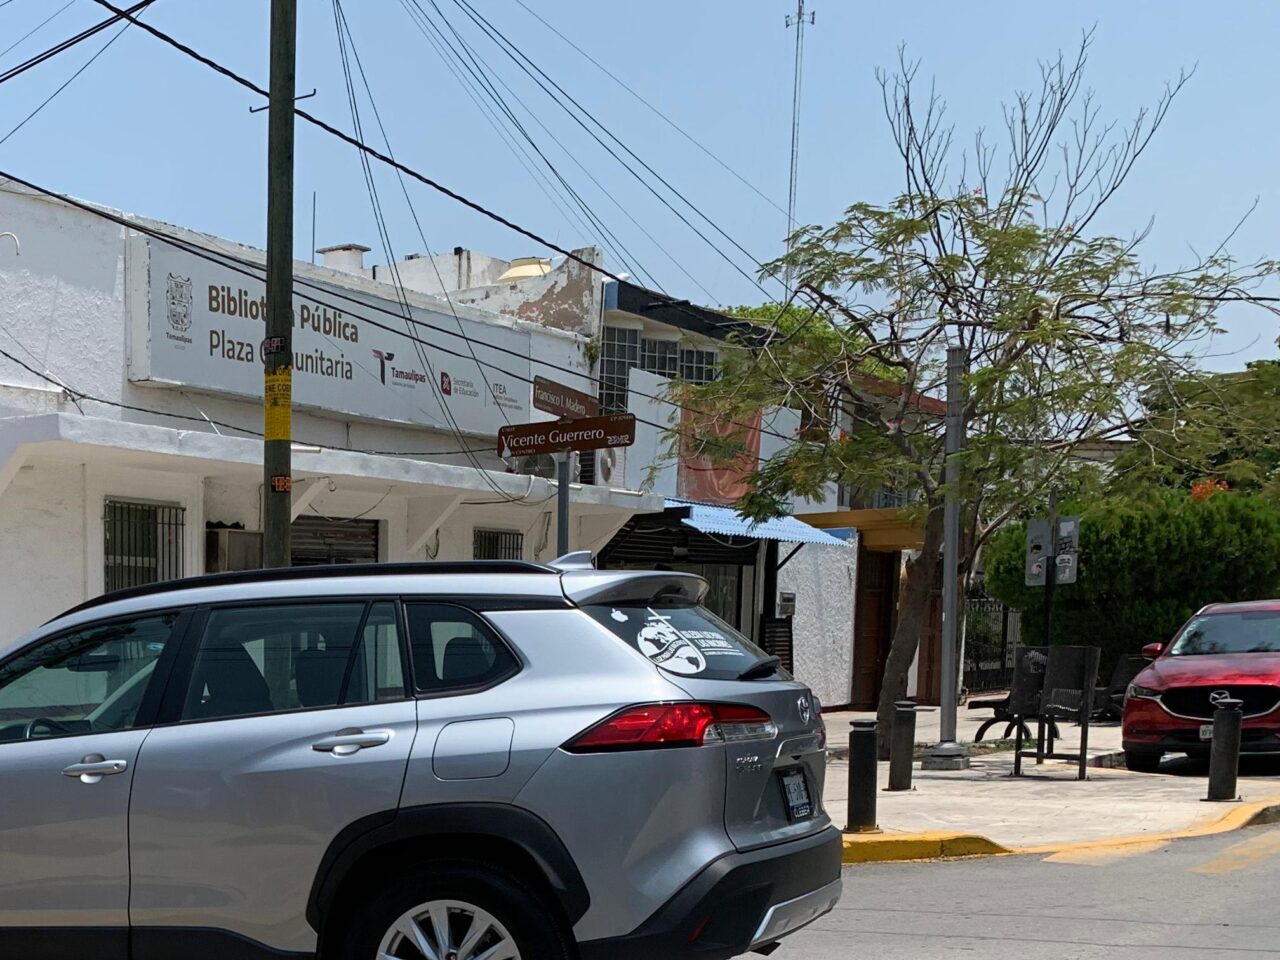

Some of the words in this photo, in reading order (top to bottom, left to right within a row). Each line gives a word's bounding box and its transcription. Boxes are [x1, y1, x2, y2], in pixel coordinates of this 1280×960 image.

[208, 285, 295, 327] Bibliot
[300, 304, 359, 343] Pública
[210, 330, 254, 363] Plaza
[260, 337, 353, 380] Cunitaria
[391, 367, 426, 384] Tamaulipas
[493, 383, 507, 395] ITEA
[535, 385, 560, 405] Francisco
[566, 398, 586, 415] Madero
[502, 434, 546, 447] Vicente
[549, 429, 605, 443] Guerrero
